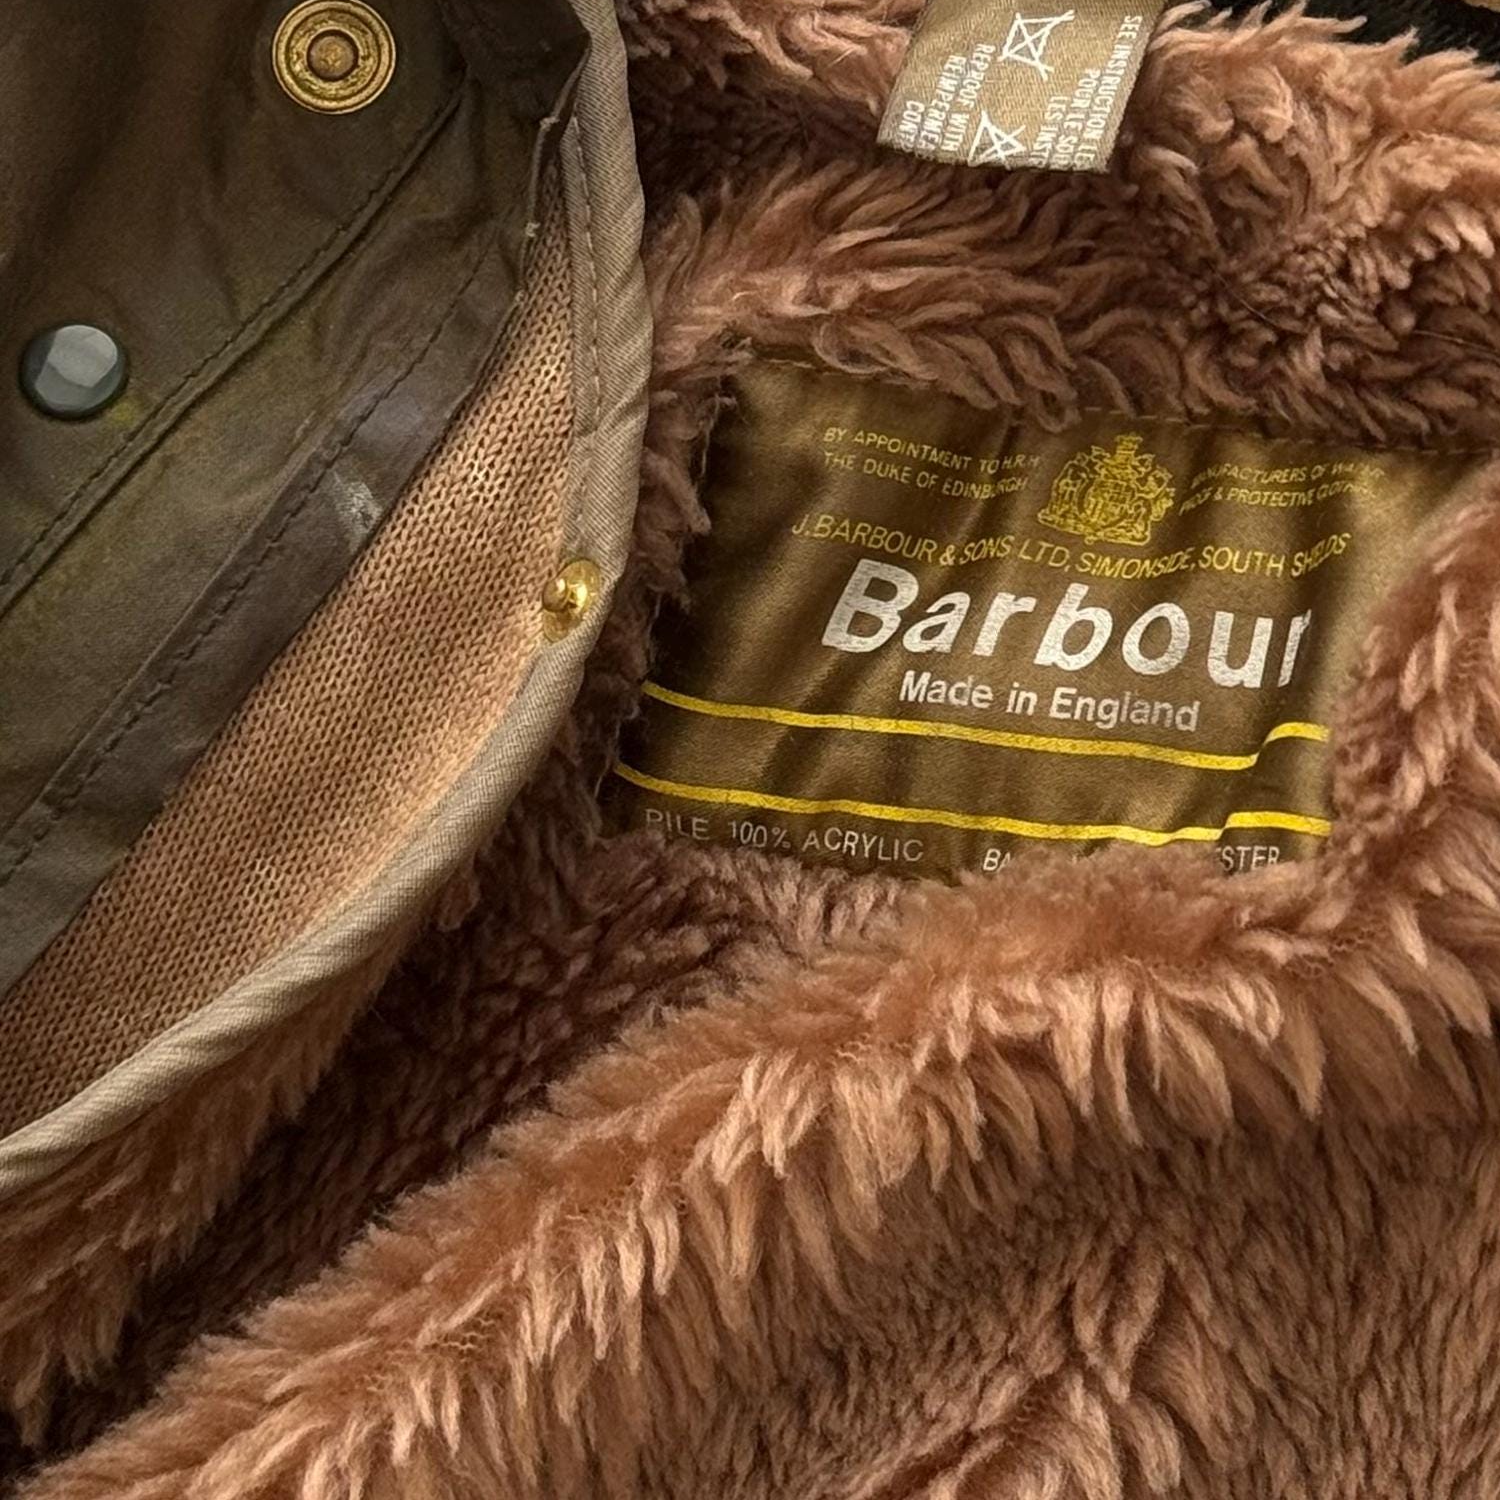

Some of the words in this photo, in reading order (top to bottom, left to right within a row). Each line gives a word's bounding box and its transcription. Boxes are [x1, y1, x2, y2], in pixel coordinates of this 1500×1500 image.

[1118, 15, 1143, 41] SEE
[1043, 95, 1068, 124] LES
[942, 112, 971, 153] WITH
[823, 427, 848, 443] BY
[853, 430, 973, 471] APPOINTMENT
[979, 459, 999, 475] TO
[823, 451, 856, 471] THE
[863, 458, 912, 484] DUKE
[916, 471, 937, 490] OF
[938, 543, 956, 567] &
[959, 534, 1015, 565] SONS
[1198, 545, 1285, 578] SOUTH
[820, 557, 1312, 689] Barbour
[900, 669, 994, 709] Made
[1006, 681, 1038, 716] in
[1049, 685, 1201, 732] England
[645, 808, 710, 841] PILE
[727, 819, 792, 850] 100%
[802, 826, 925, 863] ACRYLIC
